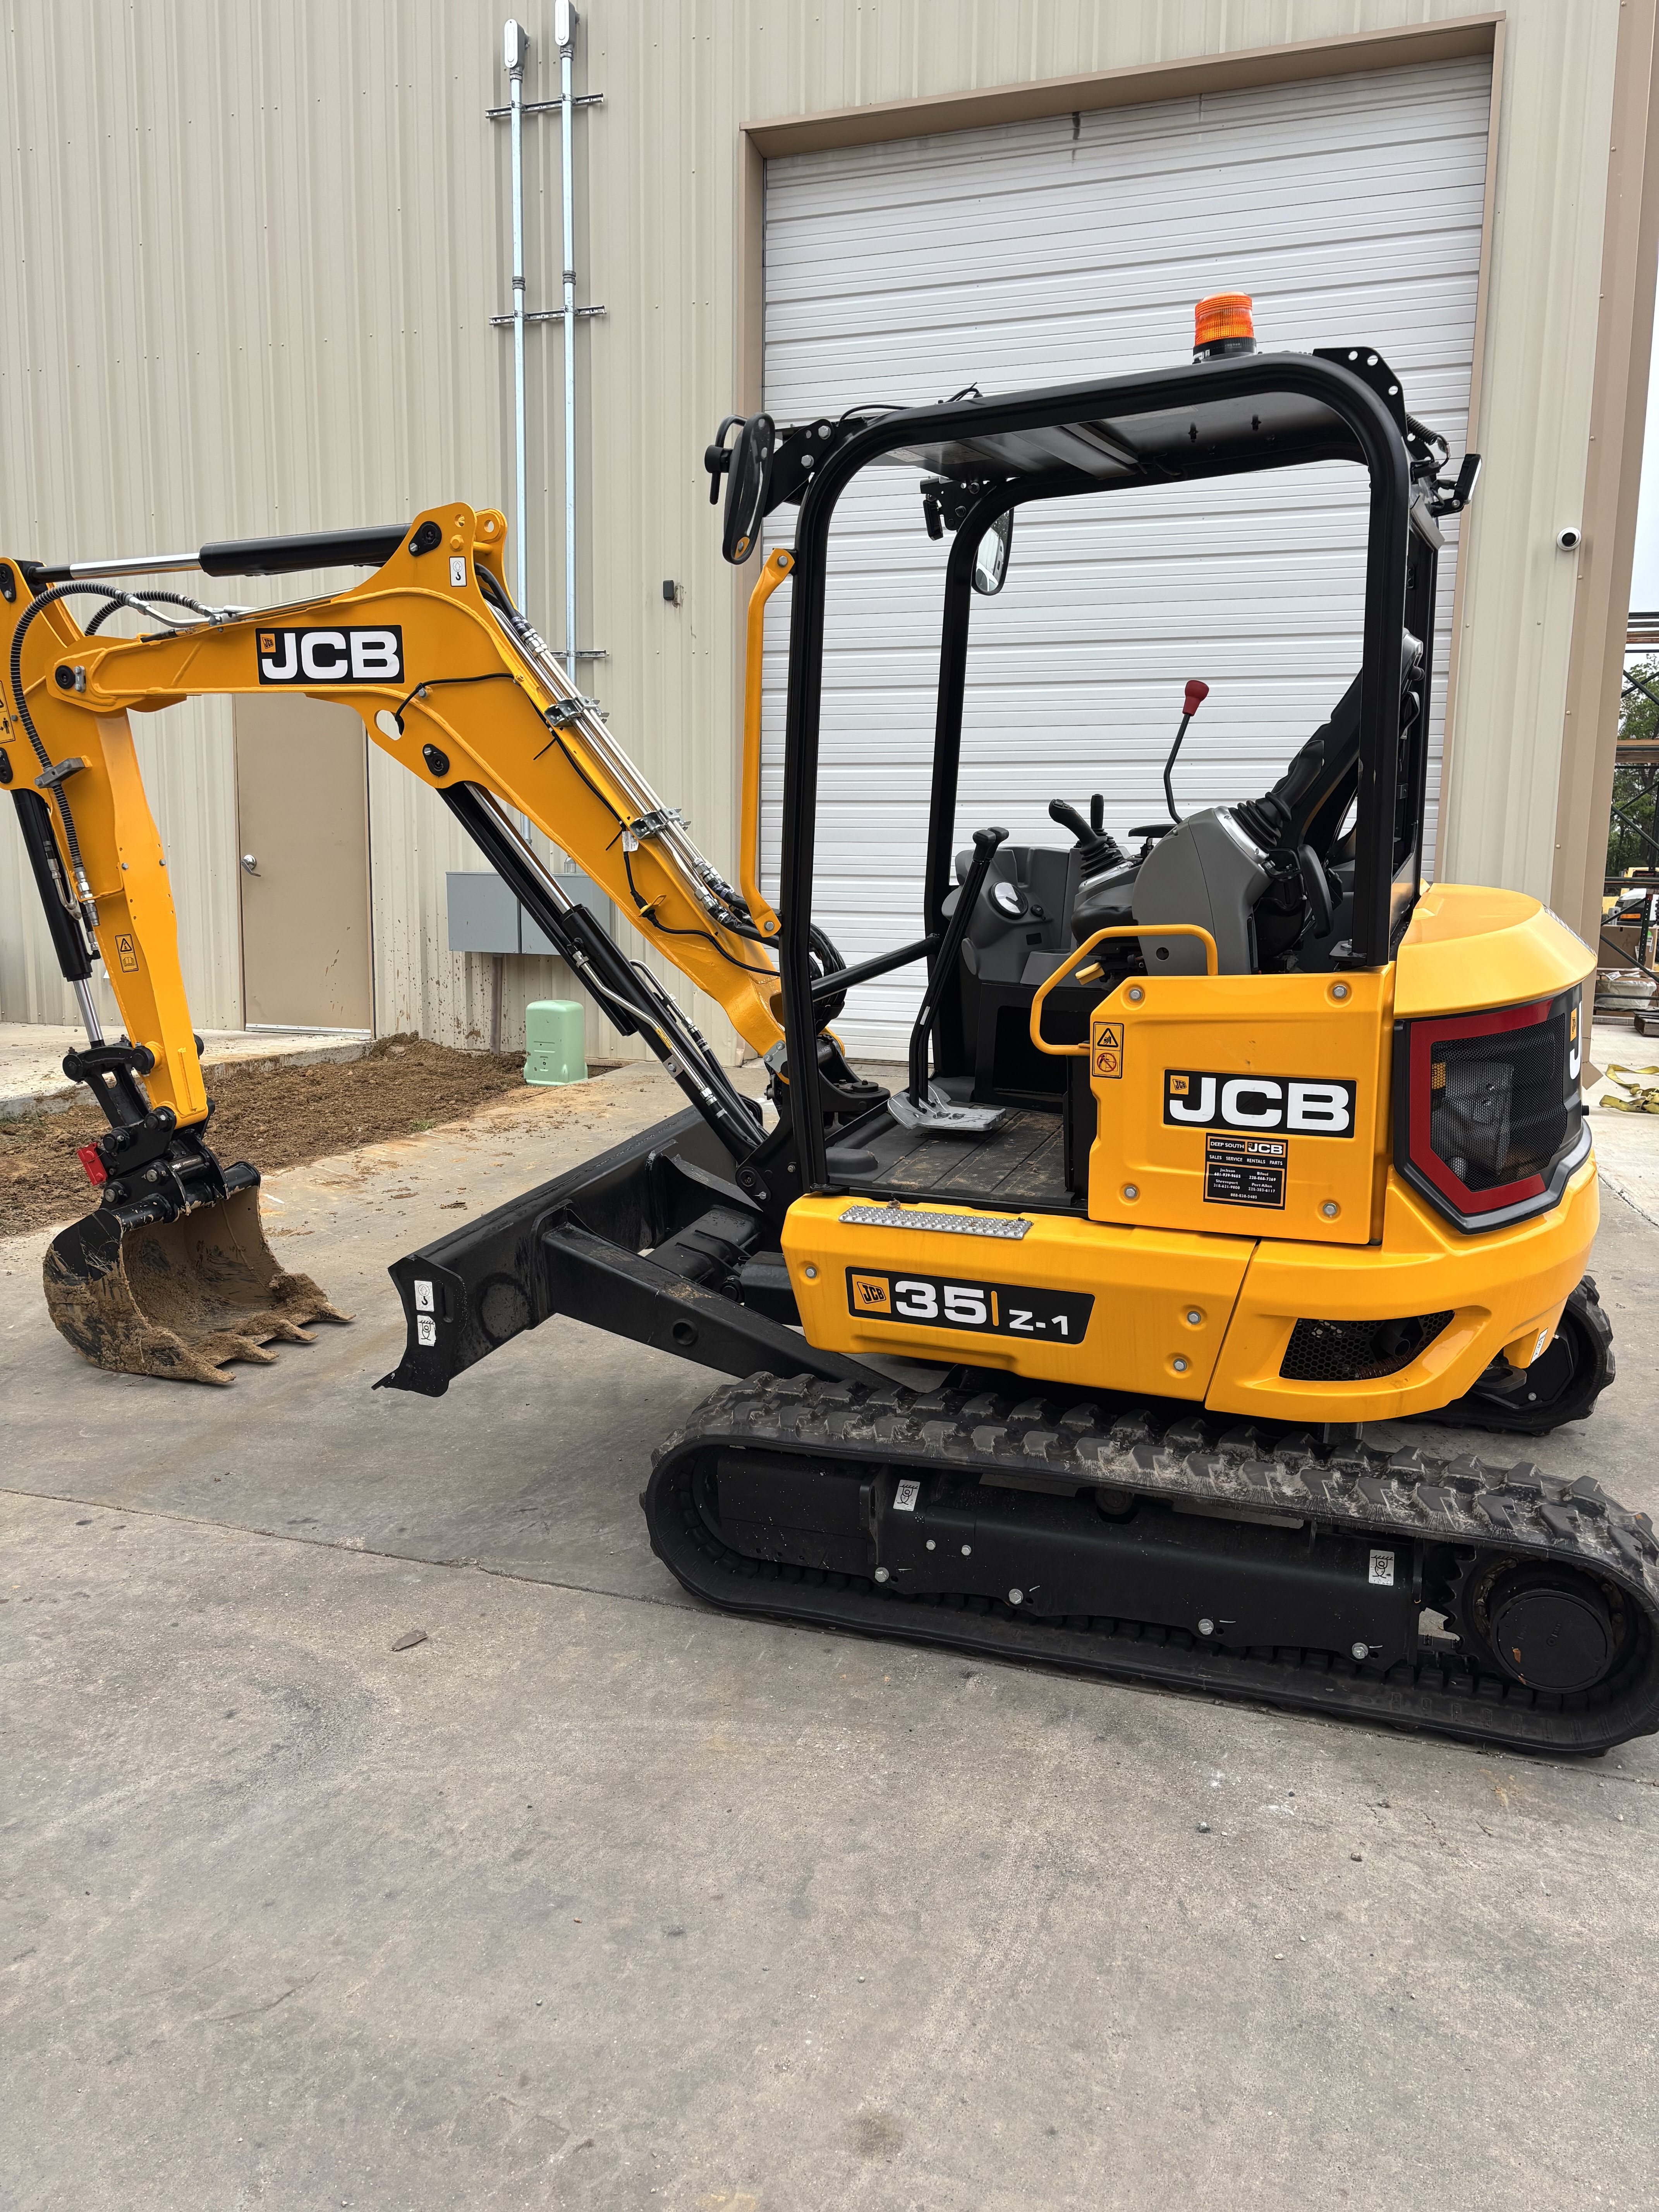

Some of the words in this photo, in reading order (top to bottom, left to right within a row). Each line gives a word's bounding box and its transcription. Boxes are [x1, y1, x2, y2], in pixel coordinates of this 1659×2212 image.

[264, 639, 273, 647] JCB
[262, 631, 400, 679] JCB
[1175, 1080, 1186, 1089] JCB
[1170, 1077, 1350, 1131] JCB
[1248, 1143, 1283, 1154] JCB
[862, 1284, 884, 1302] JCB
[895, 1281, 987, 1324] 35
